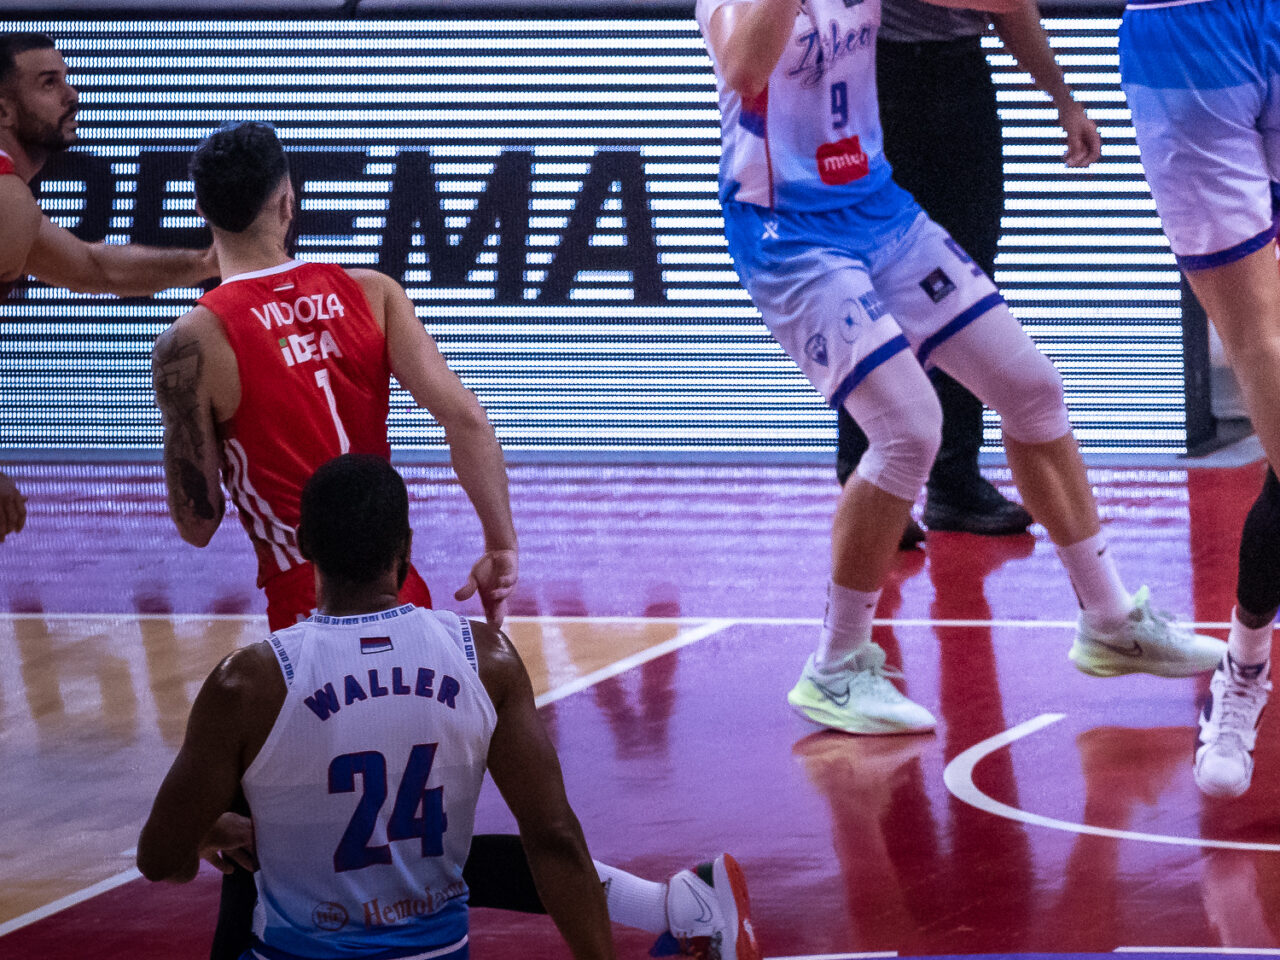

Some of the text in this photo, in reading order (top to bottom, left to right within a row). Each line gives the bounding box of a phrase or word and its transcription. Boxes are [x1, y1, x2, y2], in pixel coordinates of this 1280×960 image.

[830, 81, 848, 130] 9
[314, 368, 350, 455] 1
[304, 667, 460, 721] WALLER
[328, 742, 448, 873] 24
